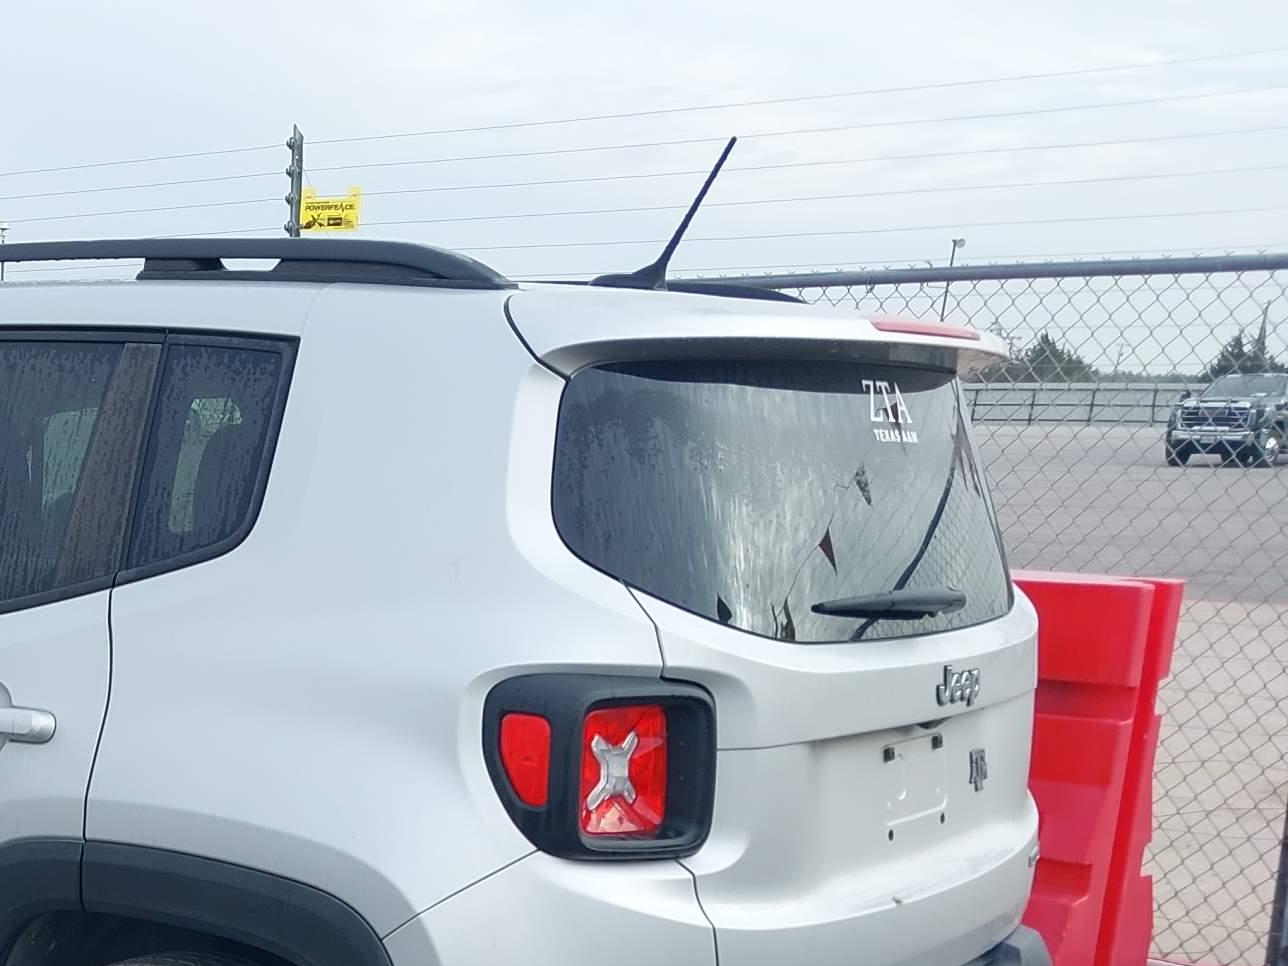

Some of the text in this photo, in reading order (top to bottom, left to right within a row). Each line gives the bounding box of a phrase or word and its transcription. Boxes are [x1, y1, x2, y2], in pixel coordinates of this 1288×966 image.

[861, 379, 913, 424] ZTA
[873, 428, 901, 443] TEXAS
[936, 664, 981, 707] Jeep
